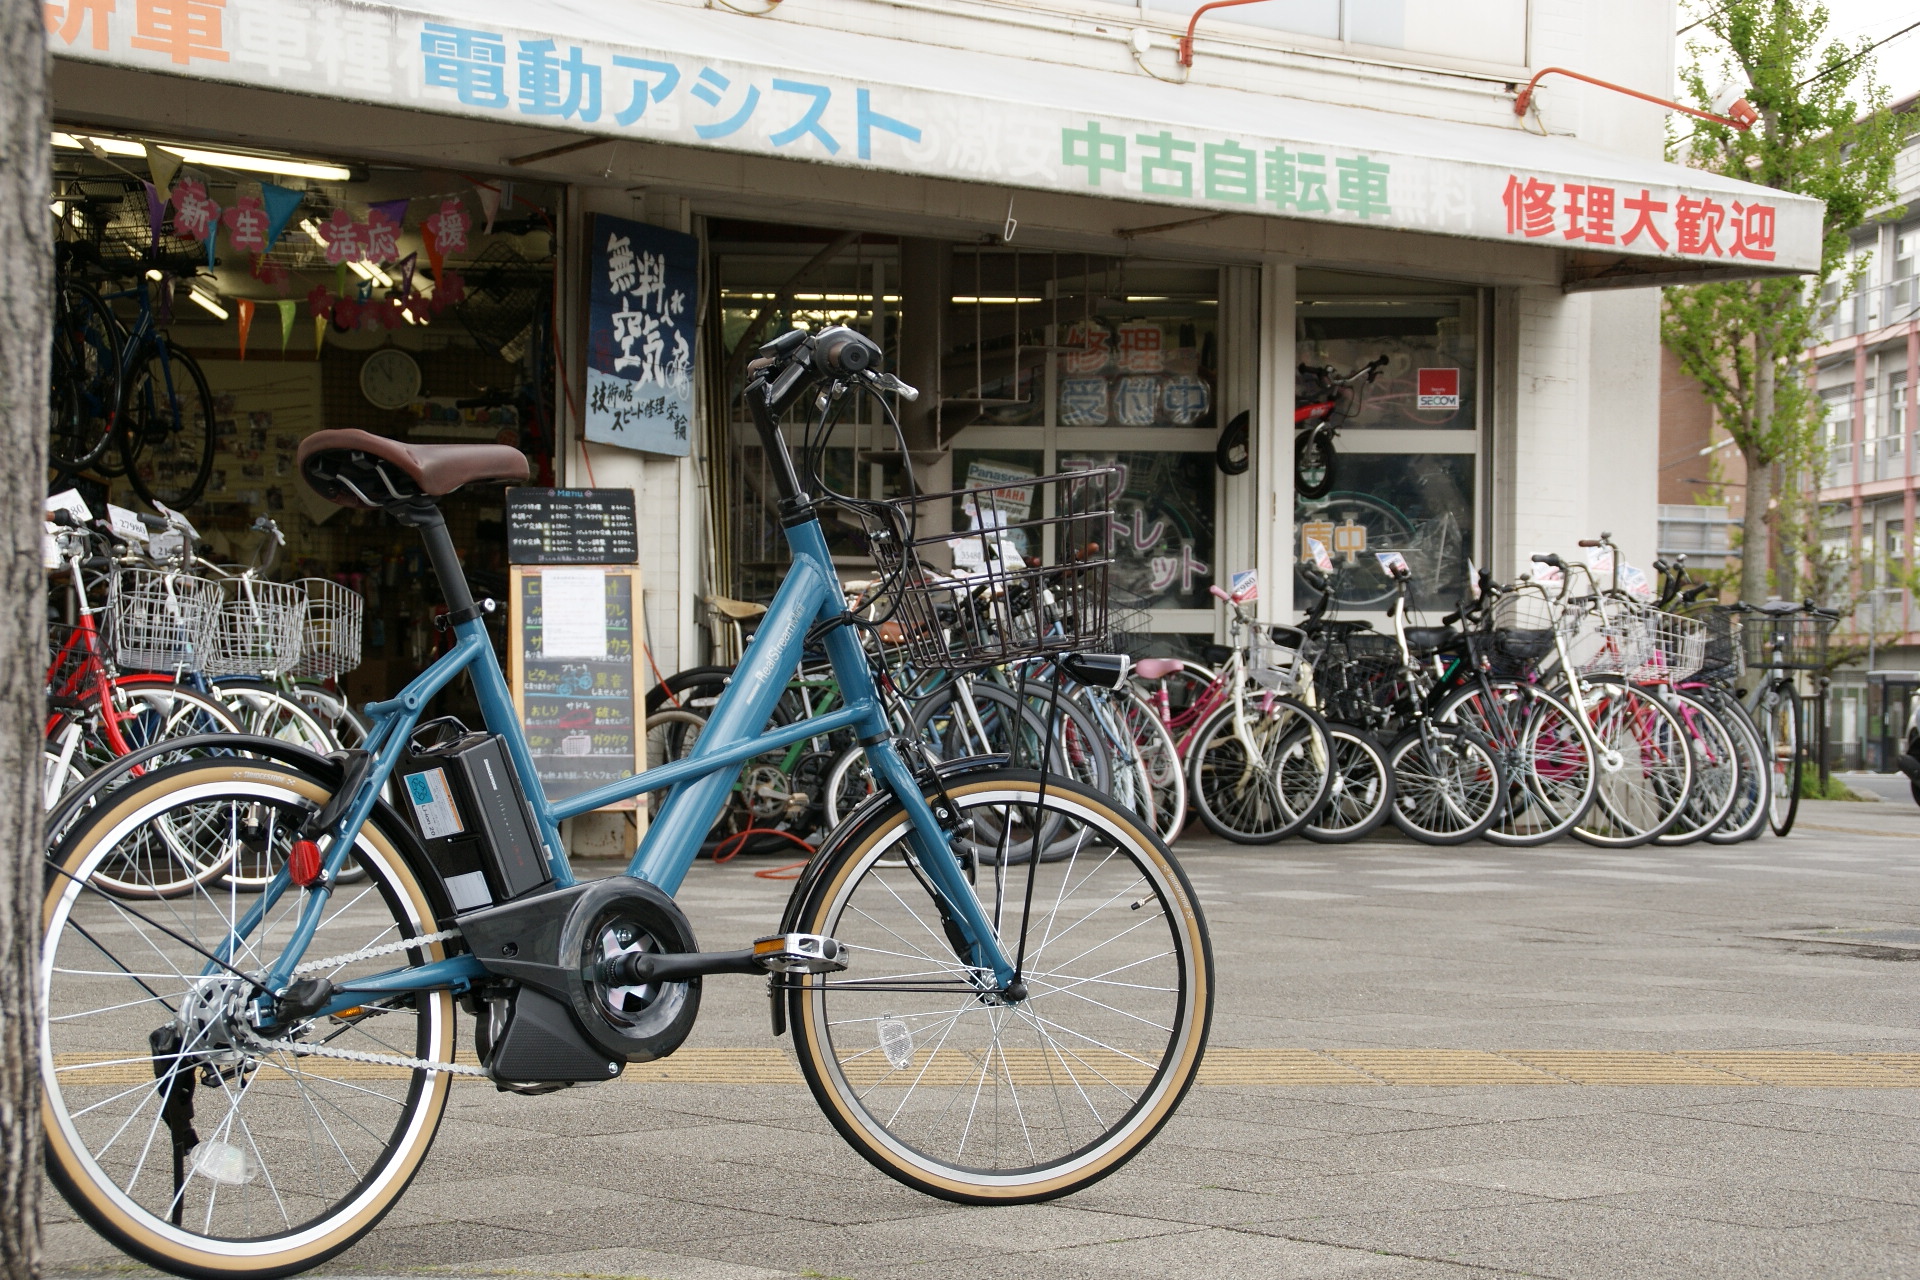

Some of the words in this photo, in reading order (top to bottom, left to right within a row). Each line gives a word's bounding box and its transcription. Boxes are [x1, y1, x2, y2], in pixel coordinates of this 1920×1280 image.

[421, 22, 922, 160] 電動アシスト
[1062, 121, 1391, 219] 中古自転車
[1502, 174, 1776, 261] 修理大歓迎
[607, 232, 666, 314] 無料
[612, 296, 665, 391] 空気
[1067, 327, 1162, 370] 修理
[591, 380, 633, 415] 技術の店
[1062, 376, 1207, 422] 受付中
[1420, 396, 1457, 406] SECOM
